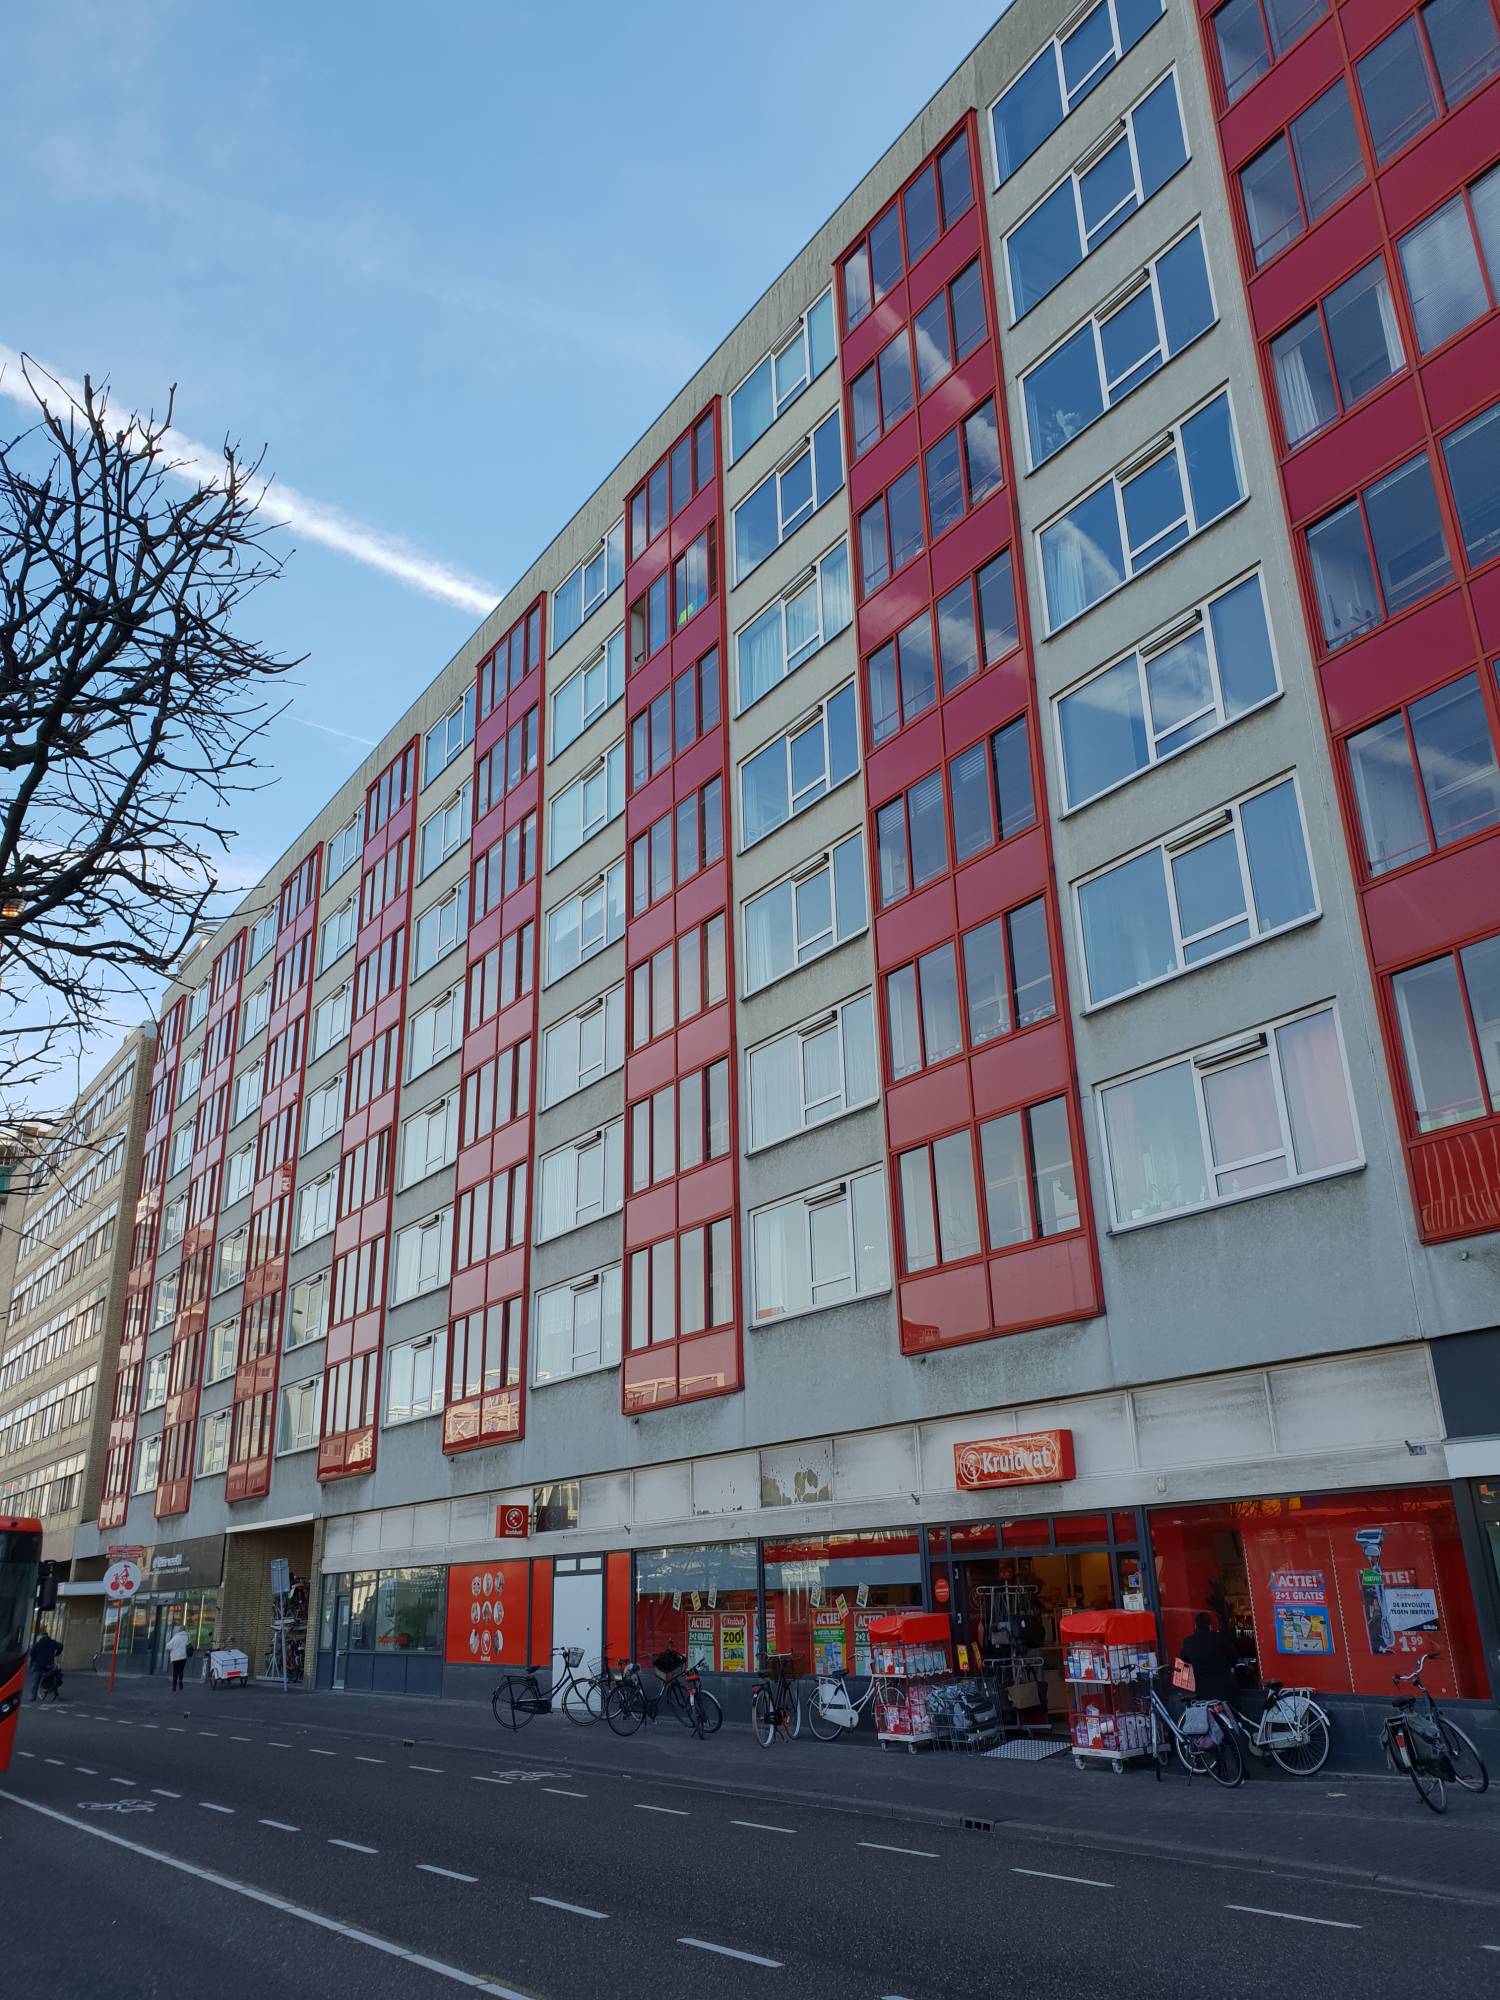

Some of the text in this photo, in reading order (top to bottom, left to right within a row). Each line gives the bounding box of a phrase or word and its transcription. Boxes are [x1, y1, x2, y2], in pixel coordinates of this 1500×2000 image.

[982, 1446, 1050, 1474] Kruidvat
[1278, 1575, 1318, 1588] ACTIE!
[1292, 1591, 1324, 1600] GRATIS
[816, 1612, 841, 1625] ACTIE!
[723, 1631, 744, 1643] ZOO!
